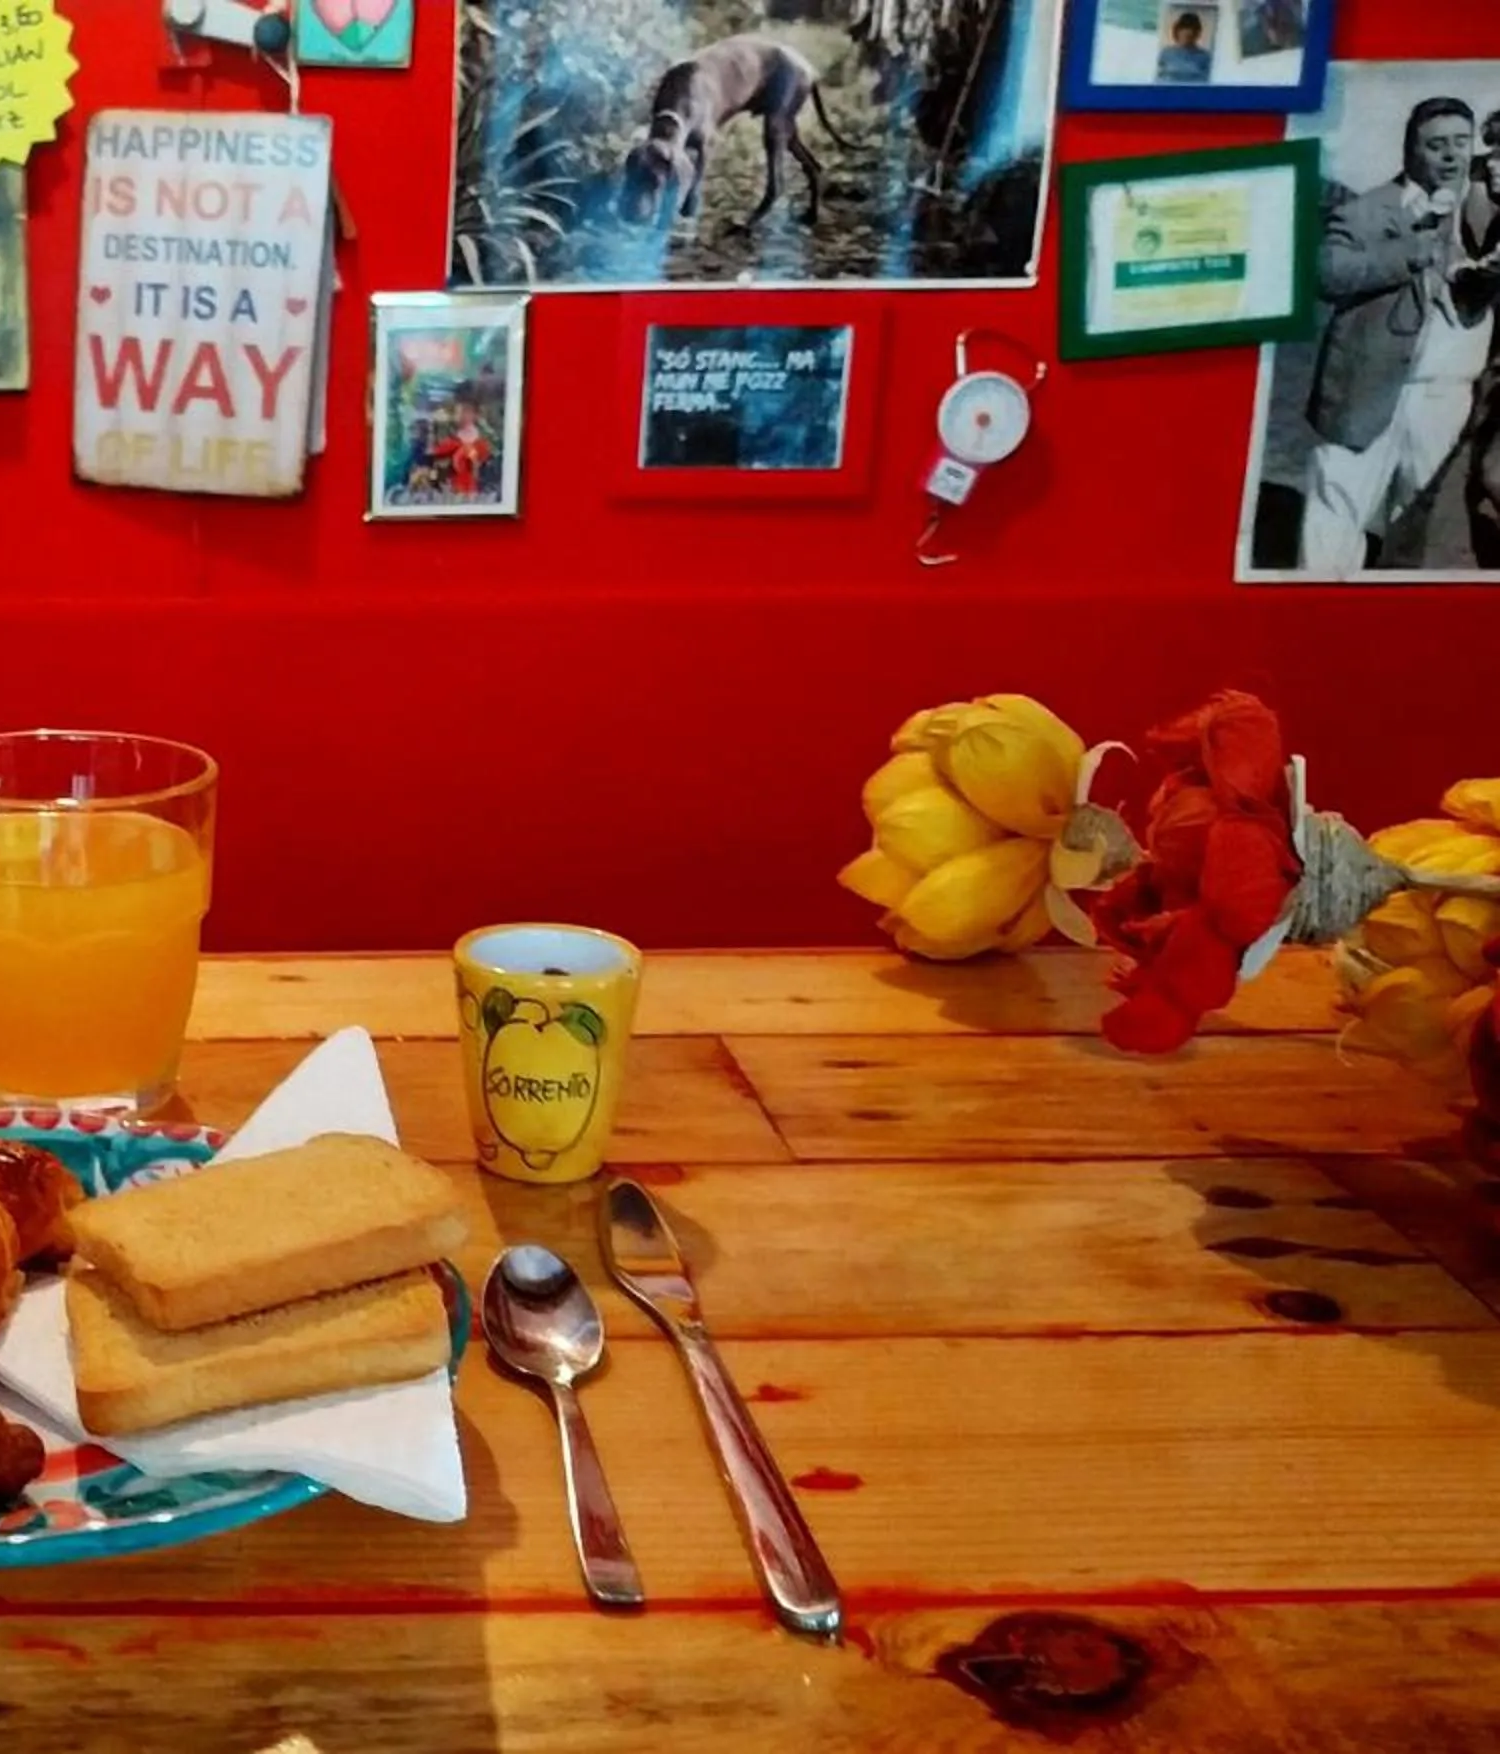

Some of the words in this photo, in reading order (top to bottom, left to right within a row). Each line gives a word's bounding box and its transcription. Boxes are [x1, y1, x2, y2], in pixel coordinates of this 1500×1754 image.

[95, 124, 319, 168] HAPPINESS
[92, 175, 136, 217] IS
[155, 178, 263, 222] NOT
[278, 187, 312, 224] A
[104, 233, 298, 270] DESTINATION.
[135, 282, 169, 317] IT
[181, 285, 218, 321] IS
[229, 289, 258, 323] A
[88, 334, 302, 421] WAY
[95, 431, 153, 472] OF
[172, 434, 272, 476] LIFE
